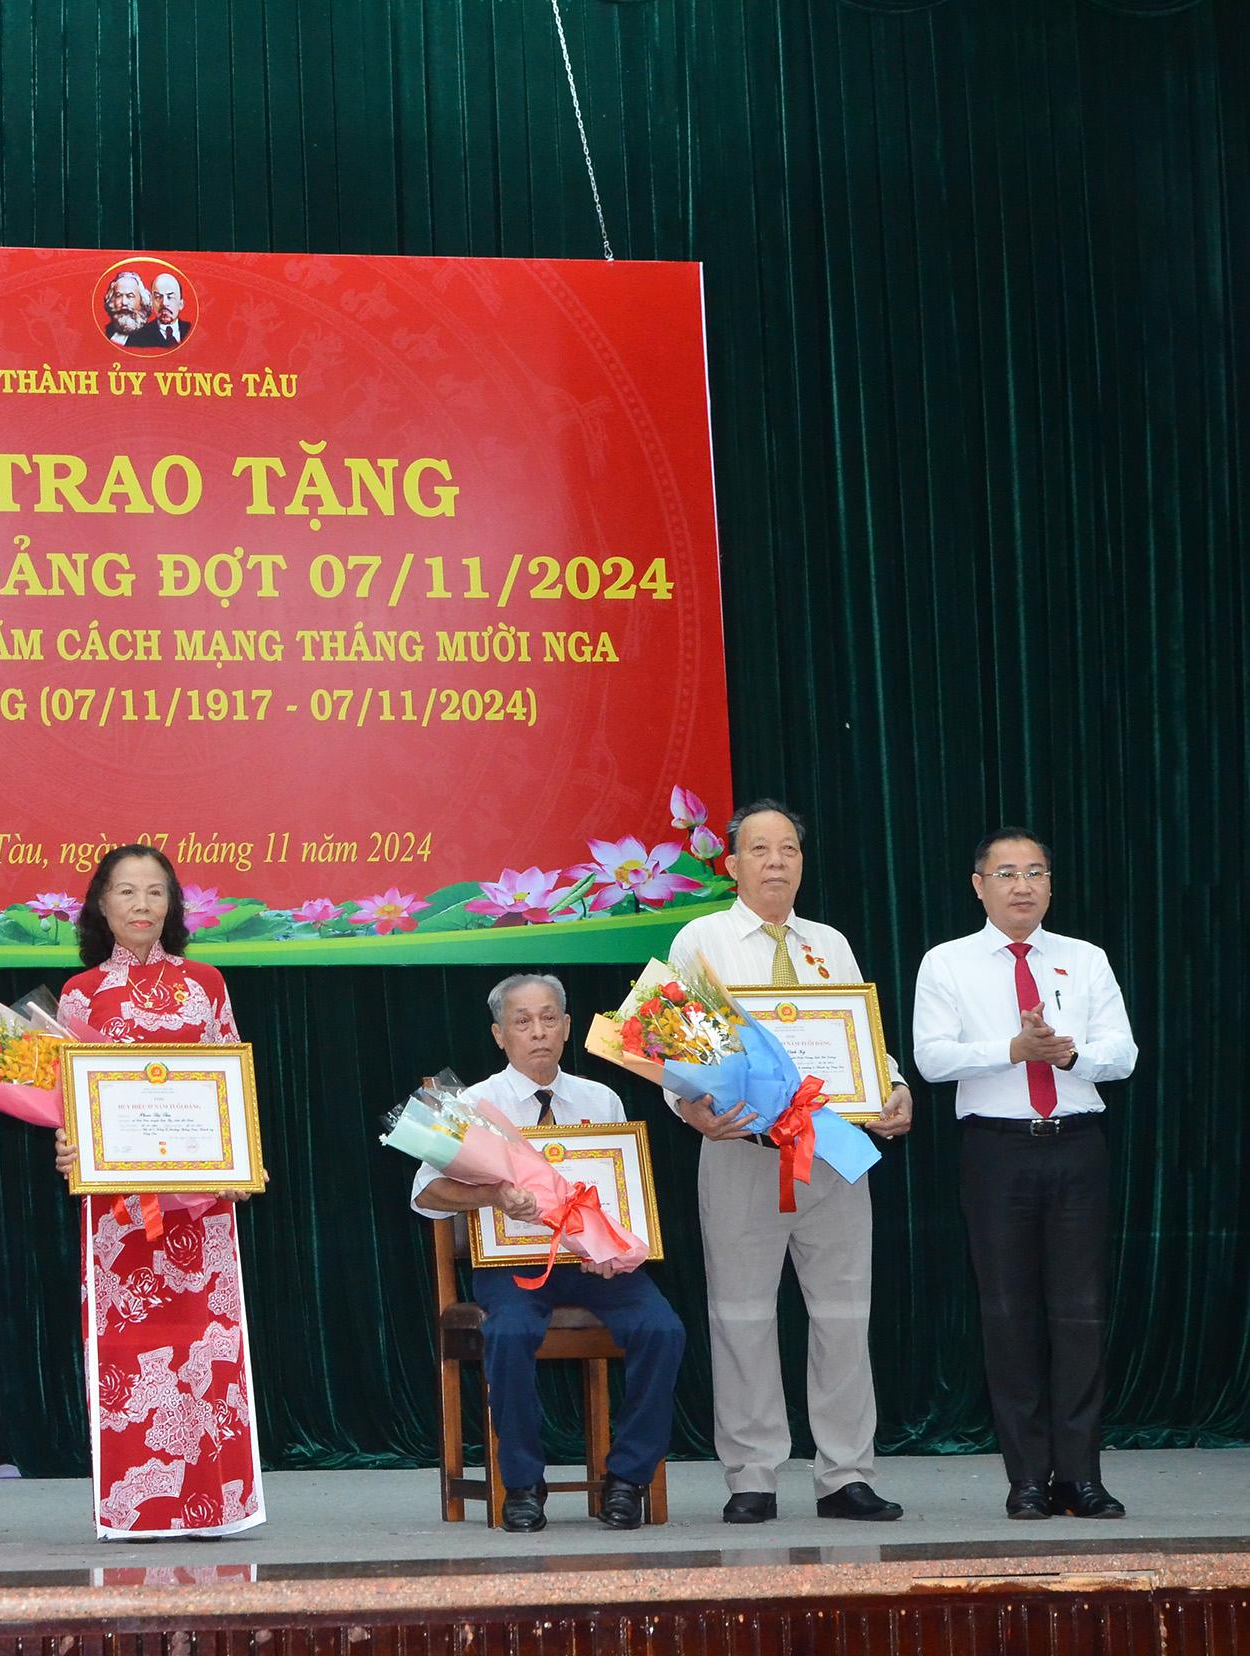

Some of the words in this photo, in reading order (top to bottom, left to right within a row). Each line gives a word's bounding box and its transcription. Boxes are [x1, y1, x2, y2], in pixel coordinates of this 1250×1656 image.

[108, 361, 146, 397] ỦY
[154, 365, 232, 398] VŨNG
[241, 366, 298, 399] TÀU
[232, 439, 461, 532] TẶNG
[157, 546, 287, 608] ĐỢT
[308, 552, 675, 609] 07/11/2024
[56, 619, 163, 662] CÁCH
[173, 628, 285, 669] MẠNG
[295, 622, 425, 663] THÁNG
[436, 622, 532, 663] MƯỜI
[541, 630, 620, 663] NGA
[40, 686, 272, 727] (07/11/1917
[285, 704, 298, 712] -
[309, 687, 538, 727] 07/11/2024)
[60, 834, 127, 873] ngà
[177, 832, 255, 872] tháng
[263, 831, 291, 864] 11
[301, 833, 358, 865] năm
[366, 831, 431, 864] 2024
